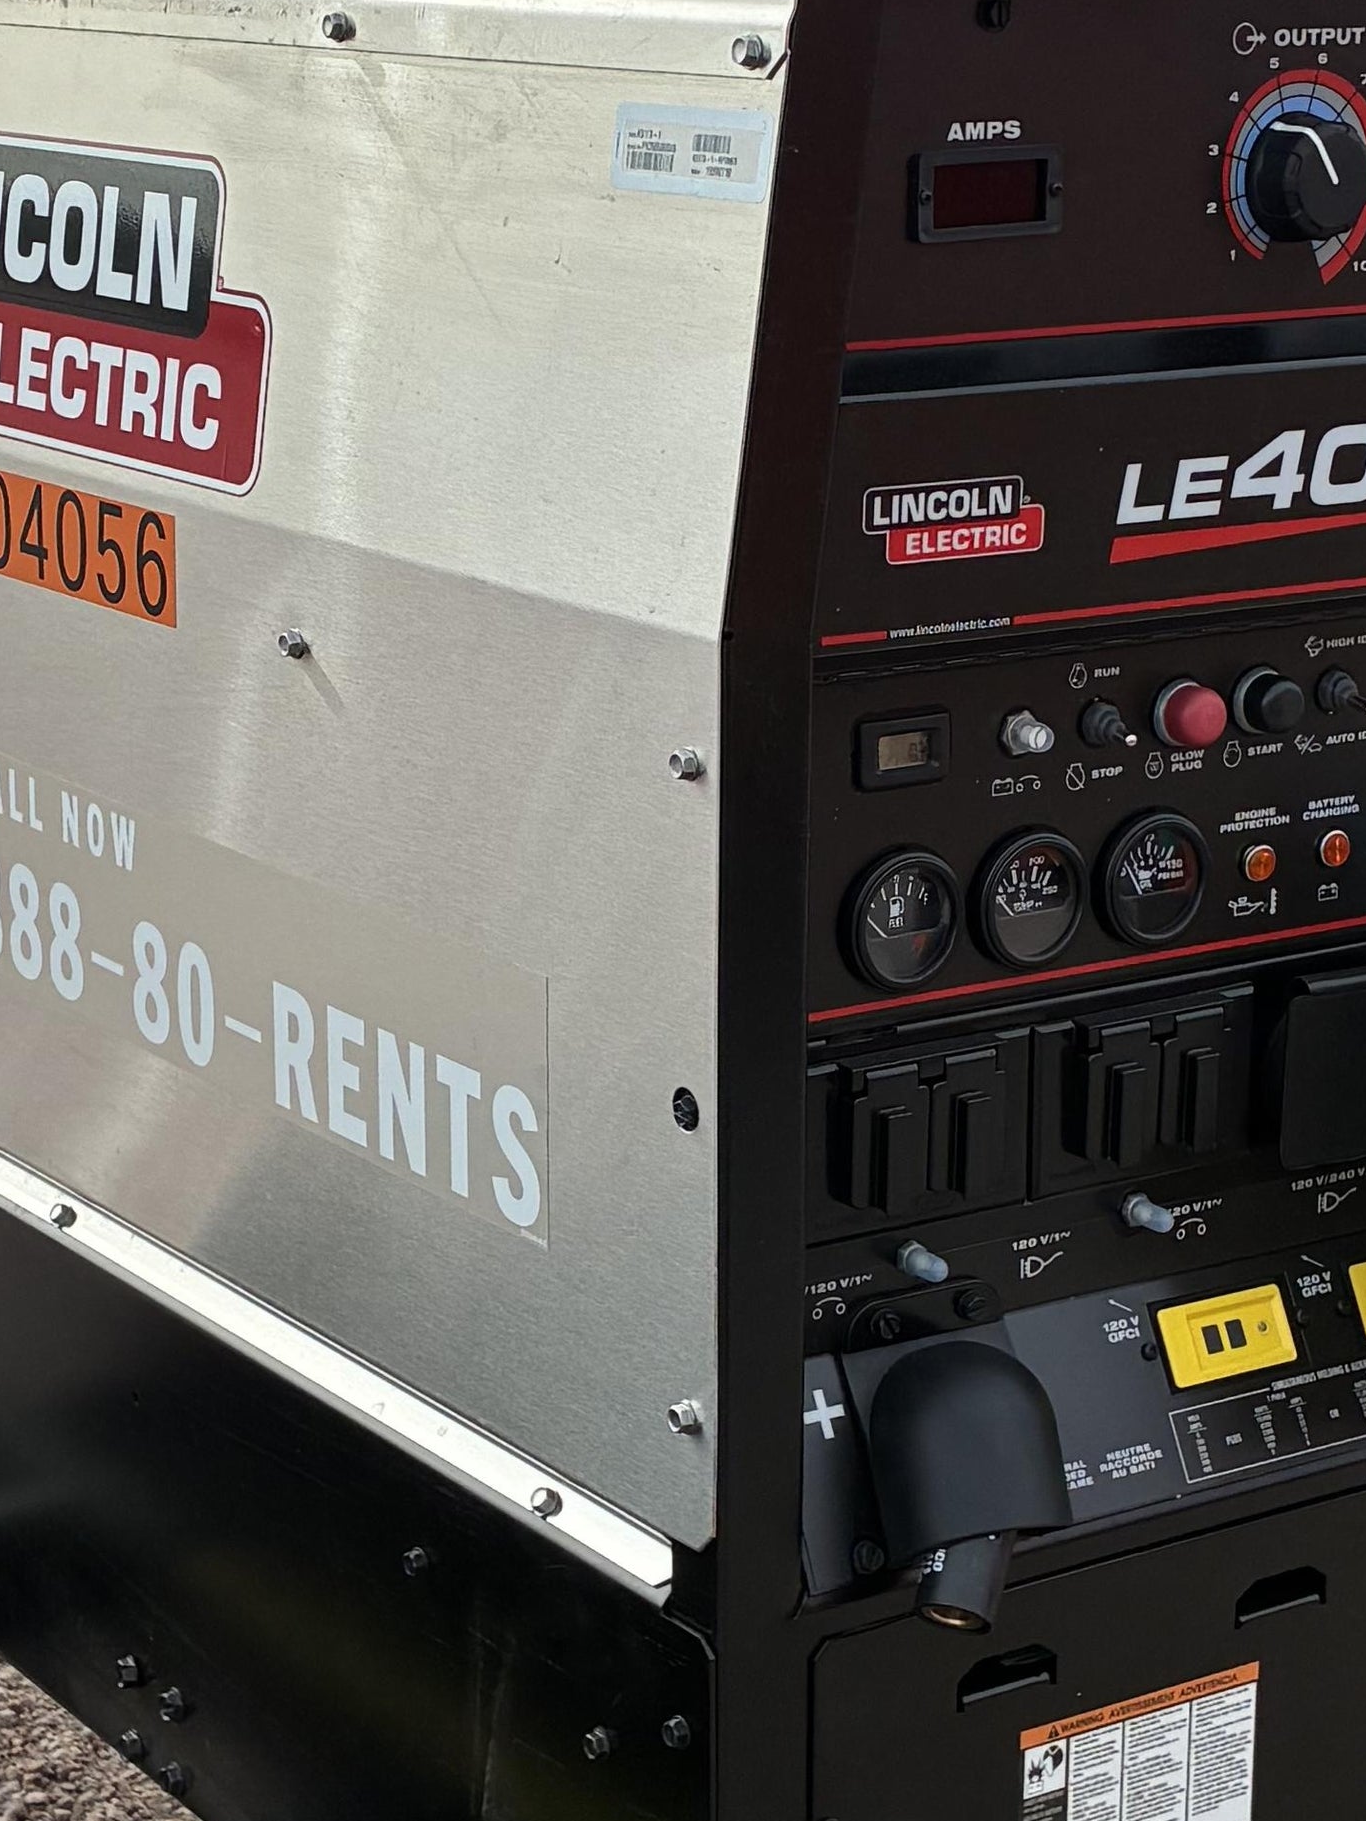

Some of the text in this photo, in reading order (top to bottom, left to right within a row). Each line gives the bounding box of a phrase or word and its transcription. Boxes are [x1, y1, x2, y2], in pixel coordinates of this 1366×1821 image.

[1274, 27, 1365, 47] OUTPUT
[1269, 57, 1280, 69] 5
[1317, 52, 1328, 65] 6
[1229, 91, 1240, 103] 4
[946, 119, 1023, 143] AMPS
[1208, 144, 1219, 156] 3
[1206, 202, 1217, 214] 2
[872, 482, 1014, 526] LINCOLN
[906, 521, 1028, 556] ELECTRIC
[889, 615, 1011, 639] www.lincolnelectric.com
[1326, 636, 1355, 649] HIGH
[1093, 666, 1121, 678] RUN
[1326, 731, 1356, 745] AUTO
[1170, 749, 1204, 762] GLOW
[1247, 743, 1283, 757] START
[1091, 765, 1124, 780] STOP
[1171, 760, 1203, 773] PLUG
[1308, 795, 1356, 810] BATTERY
[1235, 807, 1277, 821] ENGINE
[1302, 804, 1360, 821] CHARGING
[60, 791, 136, 872] NOW
[1220, 815, 1290, 834] PROTECTION
[1291, 1177, 1315, 1192] 120
[1012, 1236, 1038, 1252] 120
[1297, 1271, 1331, 1287] 120 V
[1302, 1282, 1333, 1298] GFCI
[1103, 1315, 1139, 1333] 120 V
[1108, 1327, 1140, 1344] GFCI
[1106, 1443, 1152, 1461] NEUTRE
[1099, 1450, 1163, 1473] RACCORDE
[1111, 1467, 1128, 1480] AU
[1061, 1713, 1104, 1733] WARNING
